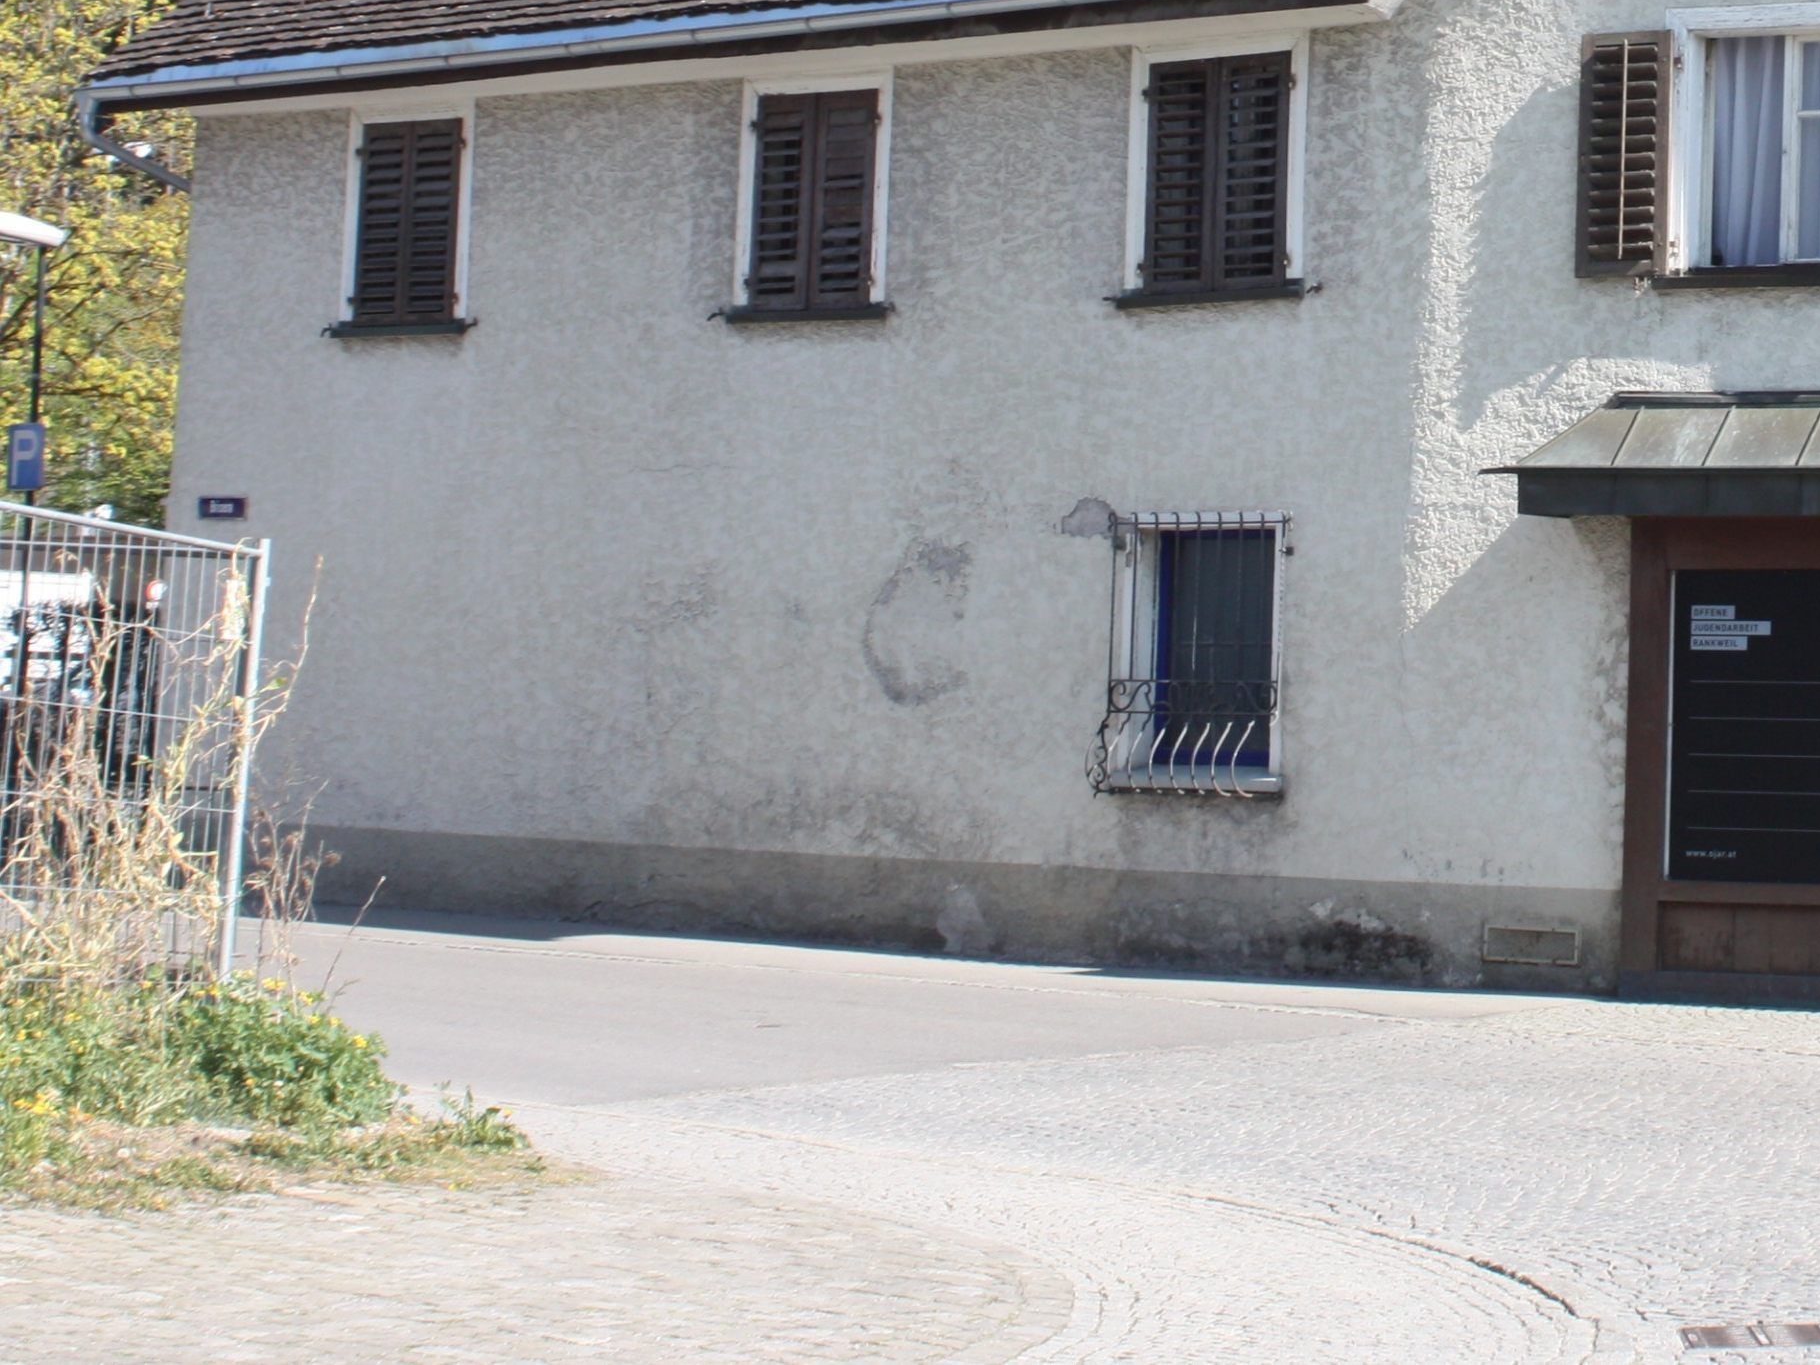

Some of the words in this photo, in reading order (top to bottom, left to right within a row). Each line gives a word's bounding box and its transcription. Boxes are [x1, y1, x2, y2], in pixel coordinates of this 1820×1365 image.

[11, 429, 38, 486] P
[1693, 608, 1728, 617] OFFENE
[1693, 623, 1759, 632] JUGENDARBEIT
[1692, 639, 1739, 647] RANKWEIL
